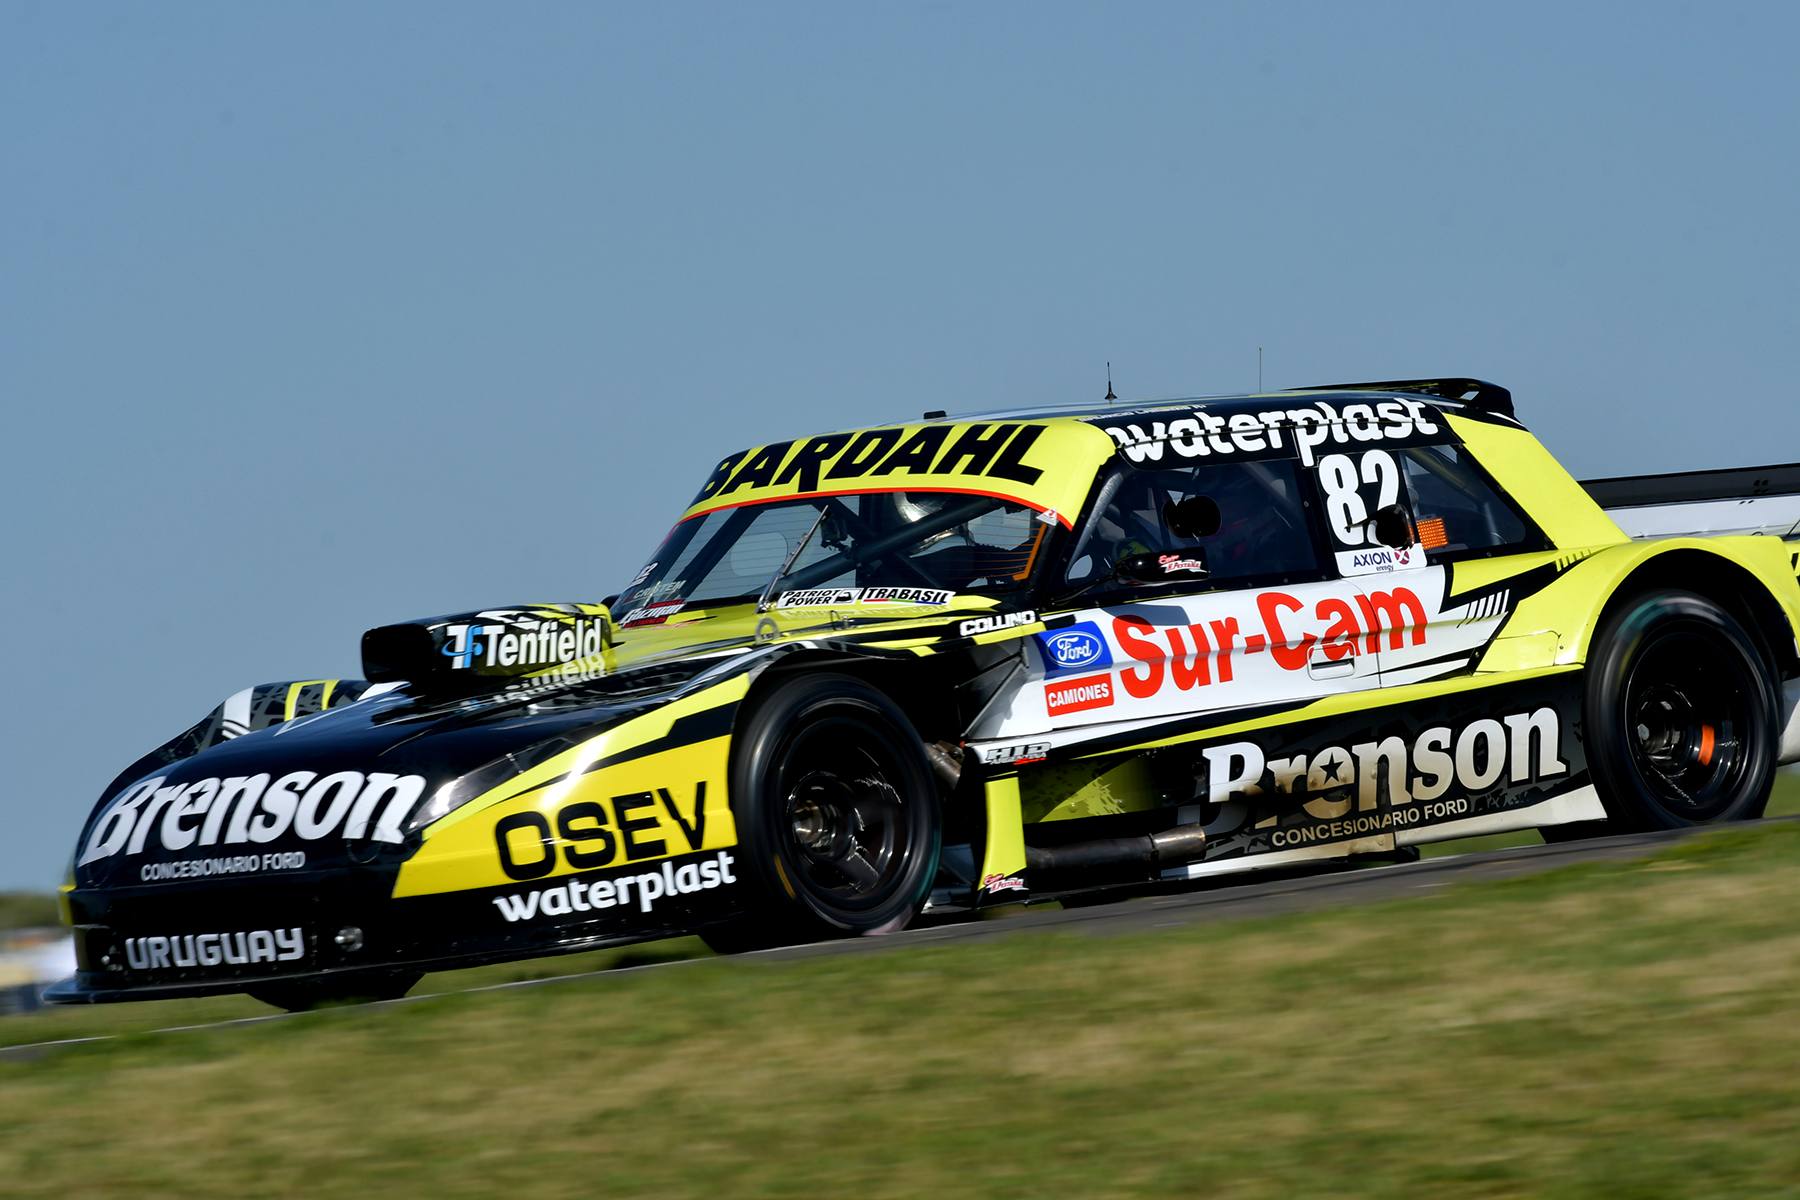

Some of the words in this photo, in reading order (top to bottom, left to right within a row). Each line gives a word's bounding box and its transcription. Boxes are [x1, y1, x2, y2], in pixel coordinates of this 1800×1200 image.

[1105, 397, 1438, 467] waterplast
[688, 424, 1049, 509] BARDAHL
[1318, 449, 1399, 546] 82
[1354, 551, 1392, 568] AXION
[783, 589, 839, 600] PATRIOT
[785, 597, 832, 607] POWER
[866, 587, 953, 604] TRABASIL
[482, 618, 602, 667] Tenfield
[959, 609, 1036, 636] COLLINO
[1112, 587, 1428, 699] Sur-Cam
[1057, 636, 1093, 661] Ford
[1048, 682, 1110, 708] CAMIONES
[1202, 707, 1567, 829] Brenson
[79, 771, 427, 867] Brenson
[495, 781, 707, 881] OSEV
[1271, 808, 1420, 847] CONCESIONARIO
[1424, 798, 1468, 819] FORD
[141, 854, 259, 881] CONCESIONARIO
[262, 851, 306, 871] FORD
[492, 851, 737, 922] waterplast
[125, 927, 305, 970] URUGUAY
